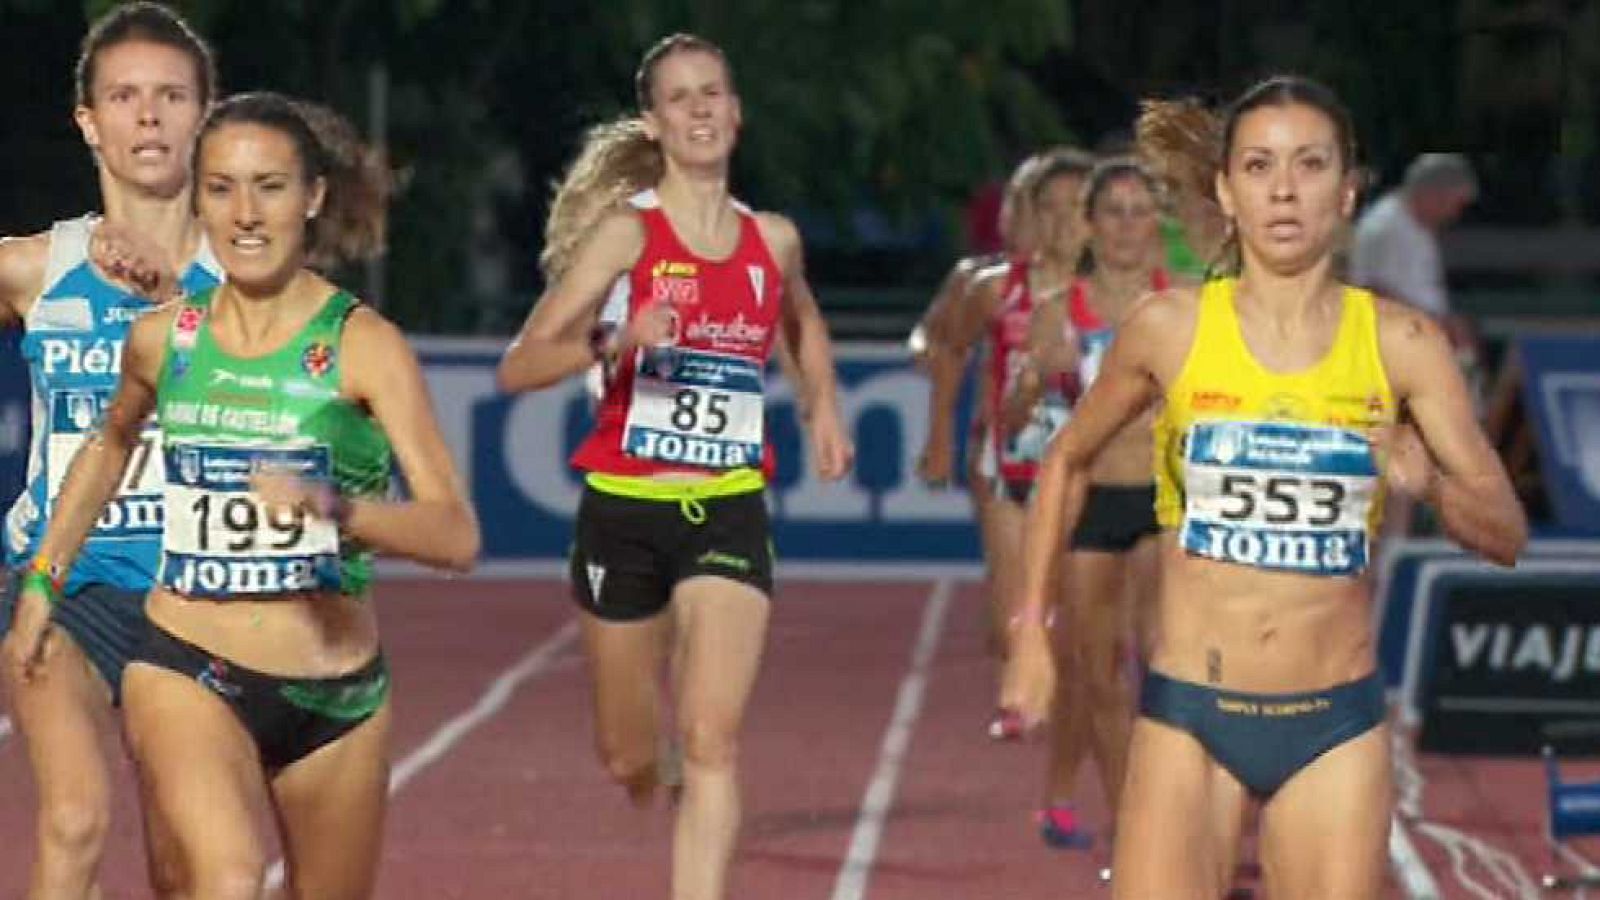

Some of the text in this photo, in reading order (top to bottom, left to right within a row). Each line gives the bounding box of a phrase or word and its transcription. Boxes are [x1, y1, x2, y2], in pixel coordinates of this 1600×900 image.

[41, 336, 122, 374] Piél
[672, 388, 731, 435] 85
[96, 500, 163, 530] om
[192, 494, 305, 552] 199
[1221, 474, 1346, 526] 553
